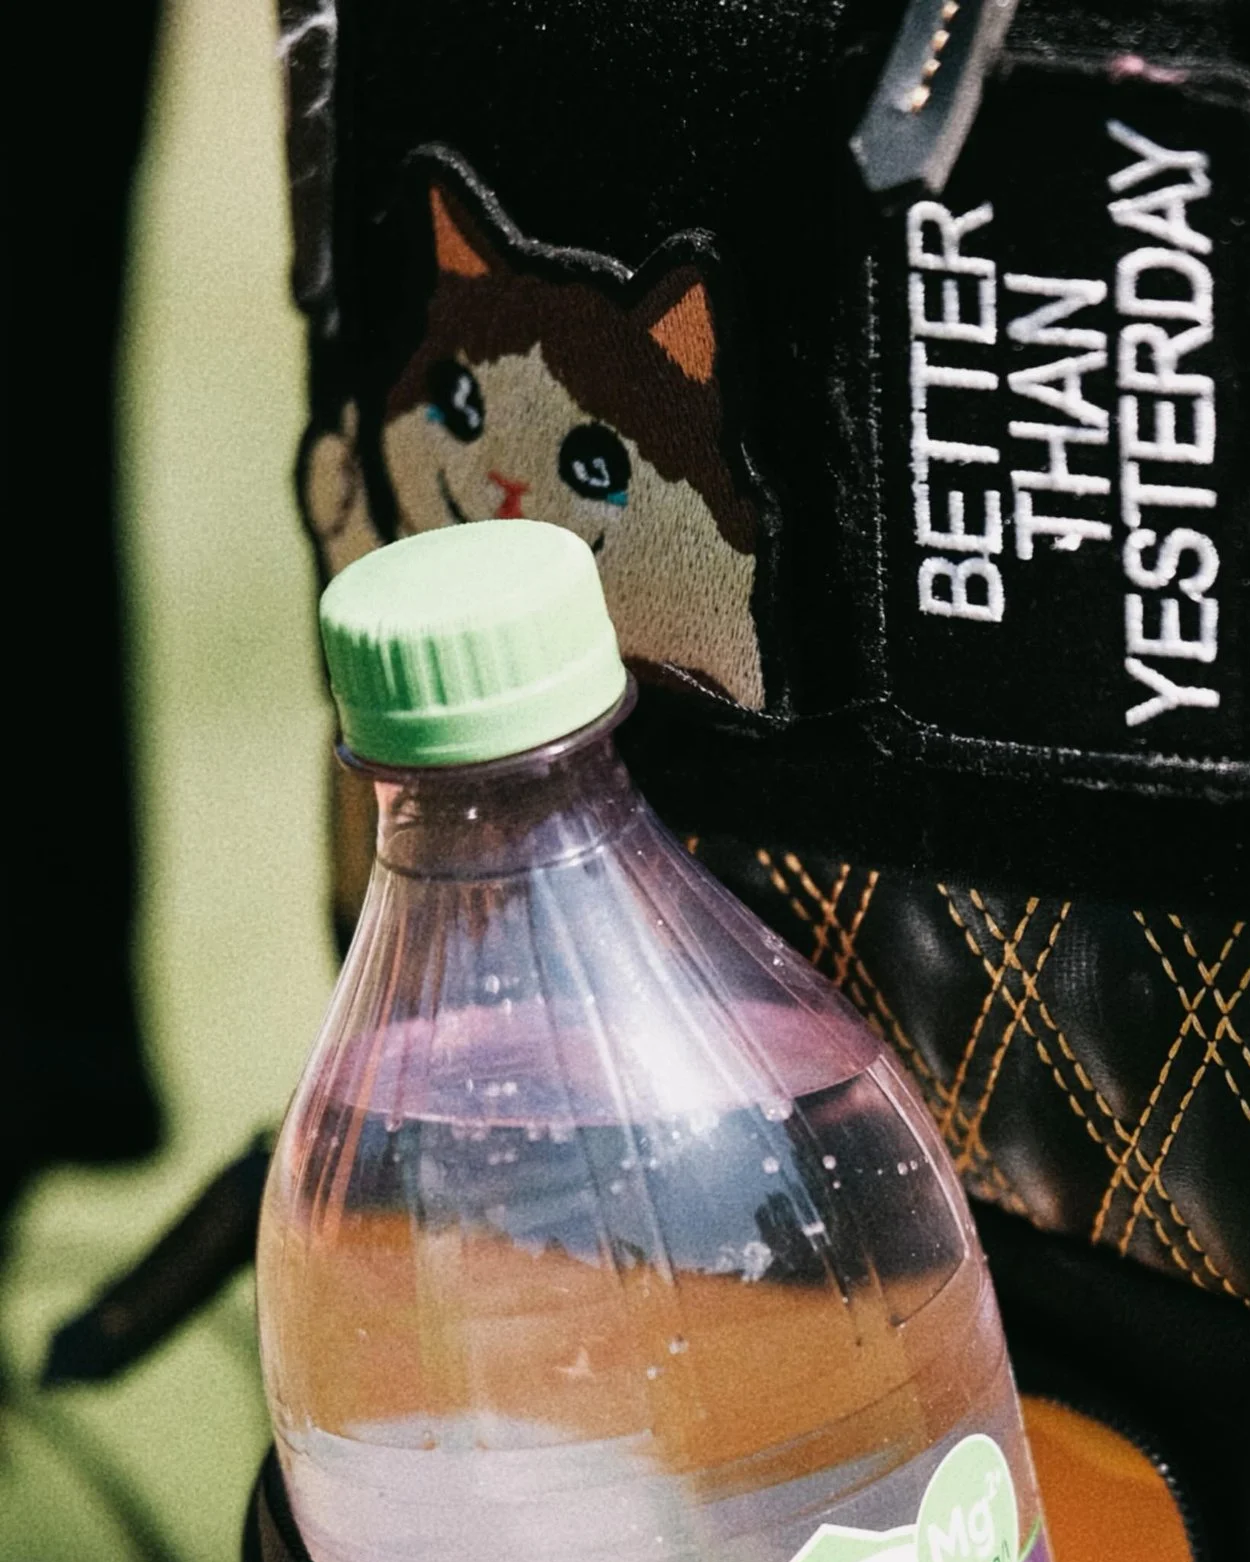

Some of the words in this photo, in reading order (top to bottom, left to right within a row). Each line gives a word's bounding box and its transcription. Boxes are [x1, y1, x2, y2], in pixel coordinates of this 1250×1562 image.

[906, 200, 1005, 623] BETTER
[1003, 272, 1112, 560] THAN
[1106, 119, 1220, 727] YESTERDAY
